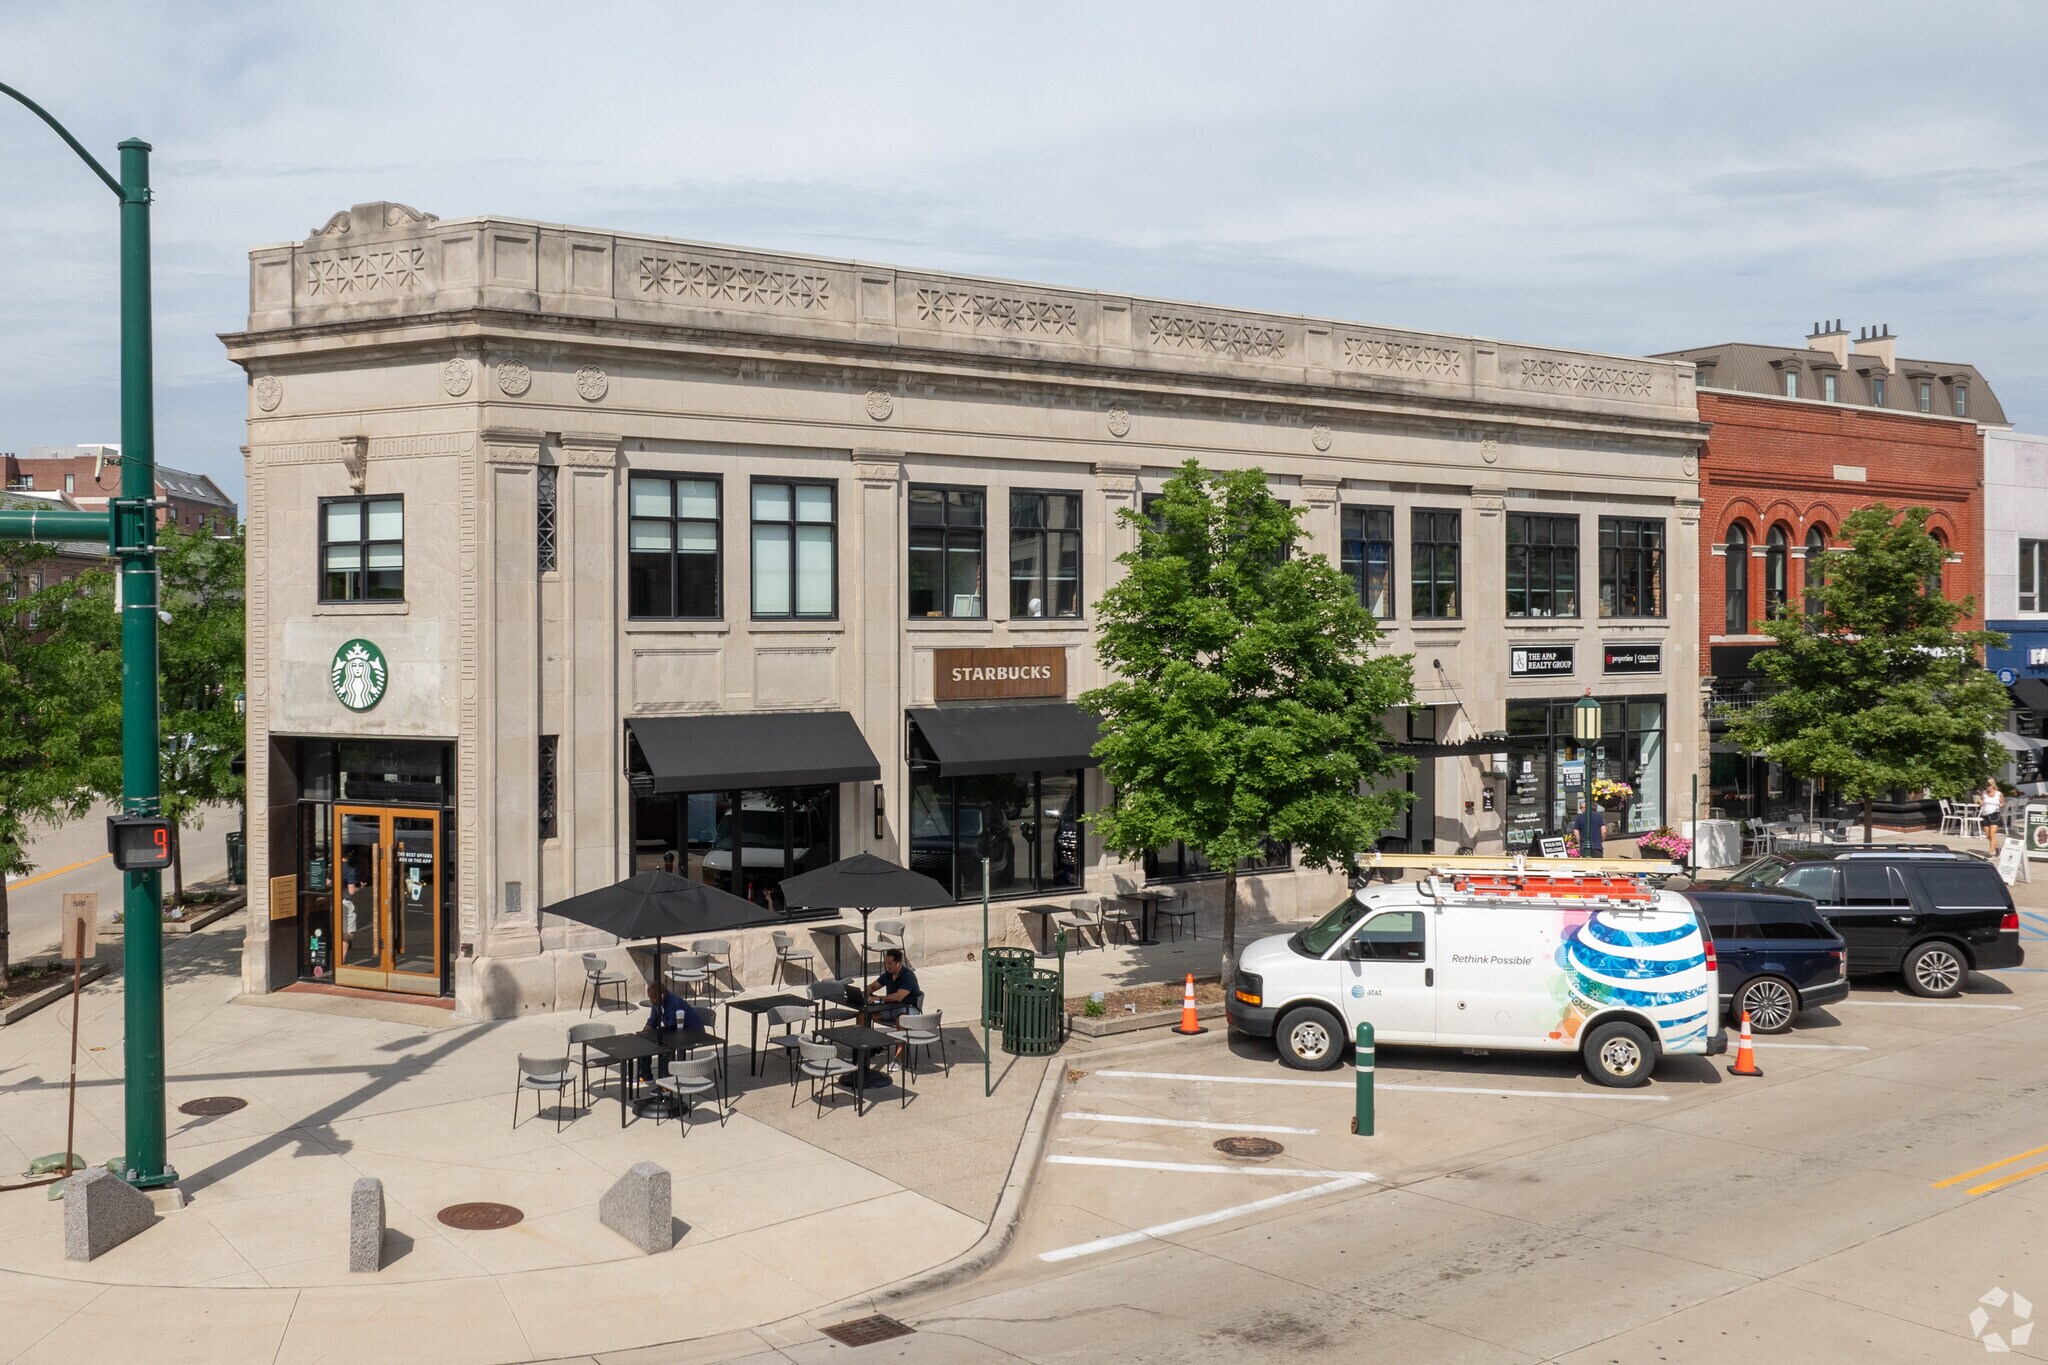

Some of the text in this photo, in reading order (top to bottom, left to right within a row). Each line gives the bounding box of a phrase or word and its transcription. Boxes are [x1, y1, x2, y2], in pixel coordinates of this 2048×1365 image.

[1528, 661, 1552, 669] REALTY
[952, 665, 1051, 681] STARBUCKS
[154, 829, 167, 858] 9
[1451, 954, 1532, 965] Rethink Possible
